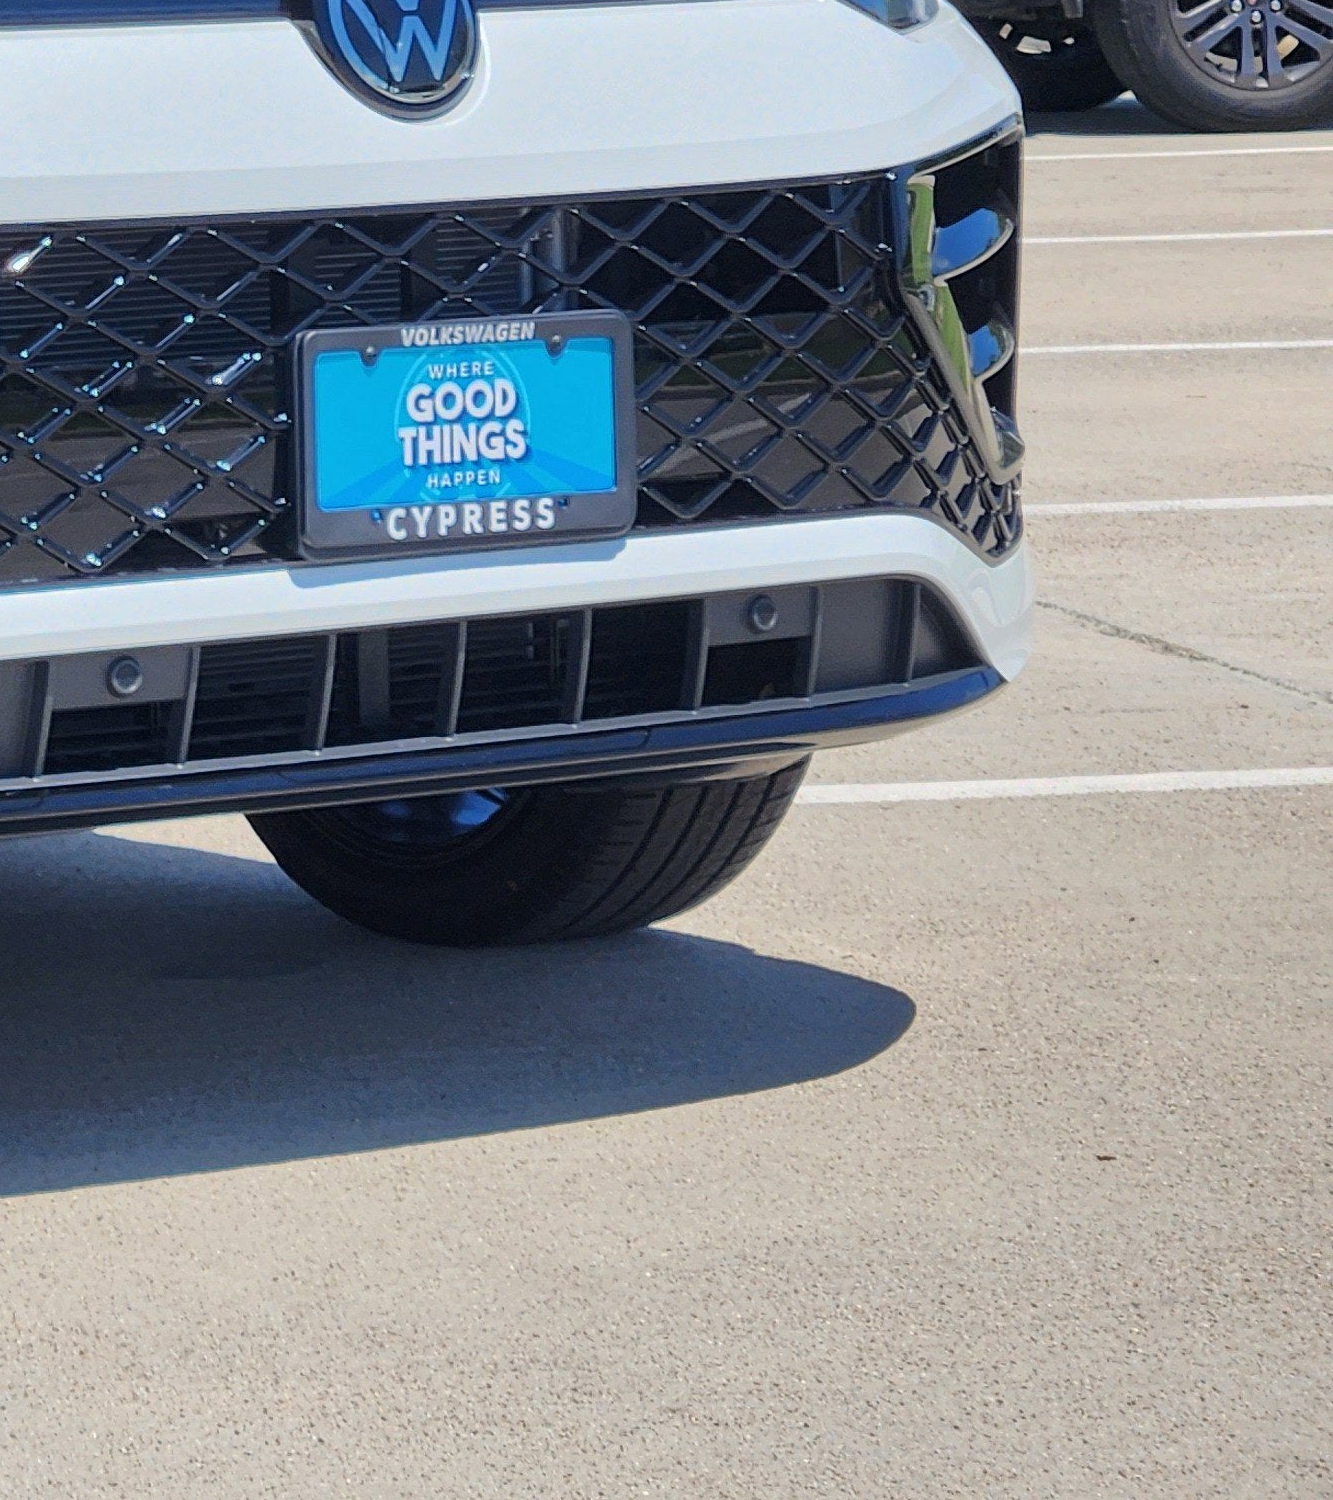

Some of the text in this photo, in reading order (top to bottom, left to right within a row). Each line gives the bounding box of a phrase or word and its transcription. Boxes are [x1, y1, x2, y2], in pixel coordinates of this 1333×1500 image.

[401, 323, 535, 347] VOLKSWAGEN
[427, 362, 495, 380] WHERE
[407, 380, 517, 422] GOOD
[398, 420, 529, 467] THINGS
[427, 468, 501, 489] HAPPEN
[387, 498, 555, 541] CYPRESS
